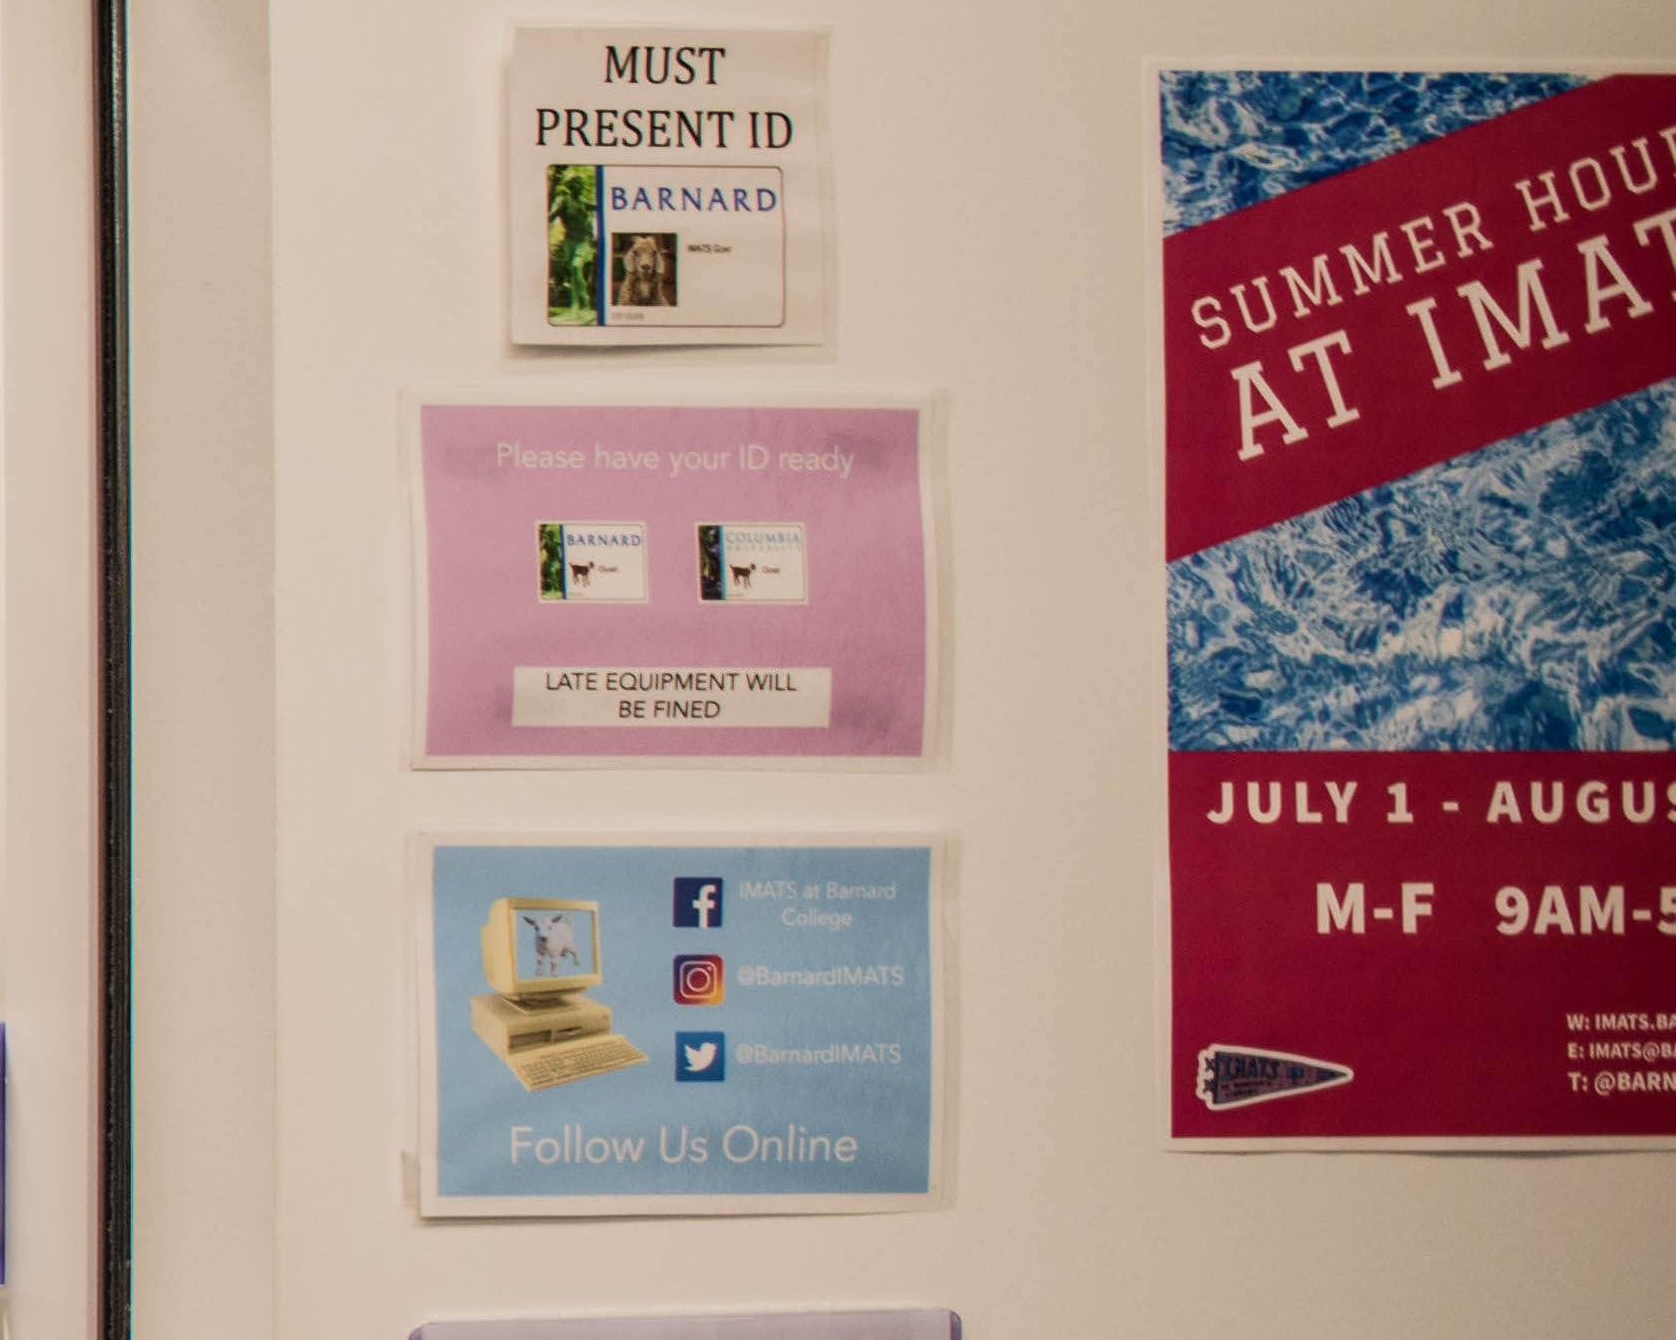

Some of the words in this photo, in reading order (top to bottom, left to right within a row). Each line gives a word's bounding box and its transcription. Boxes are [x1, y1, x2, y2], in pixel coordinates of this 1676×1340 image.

[604, 44, 727, 86] MUST
[535, 108, 735, 149] PRESENT
[749, 111, 794, 150] ID
[610, 186, 778, 213] BARNARD
[1191, 200, 1494, 350] SUMMER
[1513, 126, 1676, 233] HOU
[1229, 331, 1362, 462] AT
[496, 442, 585, 471] Please
[594, 443, 660, 472] have
[669, 448, 729, 477] your
[738, 446, 769, 469] ID
[778, 443, 855, 477] ready
[566, 533, 642, 548] BARNARD
[545, 673, 599, 692] LATE
[606, 673, 739, 696] EQUIPMENT
[745, 674, 798, 693] WILL
[618, 700, 647, 721] BE
[653, 700, 721, 721] FINED
[1206, 780, 1358, 825] JULY
[1386, 783, 1414, 825] 1
[739, 881, 798, 900] IMATS
[803, 883, 820, 900] at
[825, 882, 896, 901] Barnard
[781, 908, 853, 931] College
[1316, 882, 1436, 935] M-F
[736, 966, 904, 988] @BarnardIMATS
[1566, 1014, 1591, 1031] W:
[735, 1043, 902, 1066] @BarnardIMATS
[1567, 1043, 1585, 1059] E:
[1570, 1073, 1589, 1092] T:
[510, 1125, 645, 1164] Follow
[660, 1126, 709, 1164] Us
[723, 1125, 859, 1164] Online
